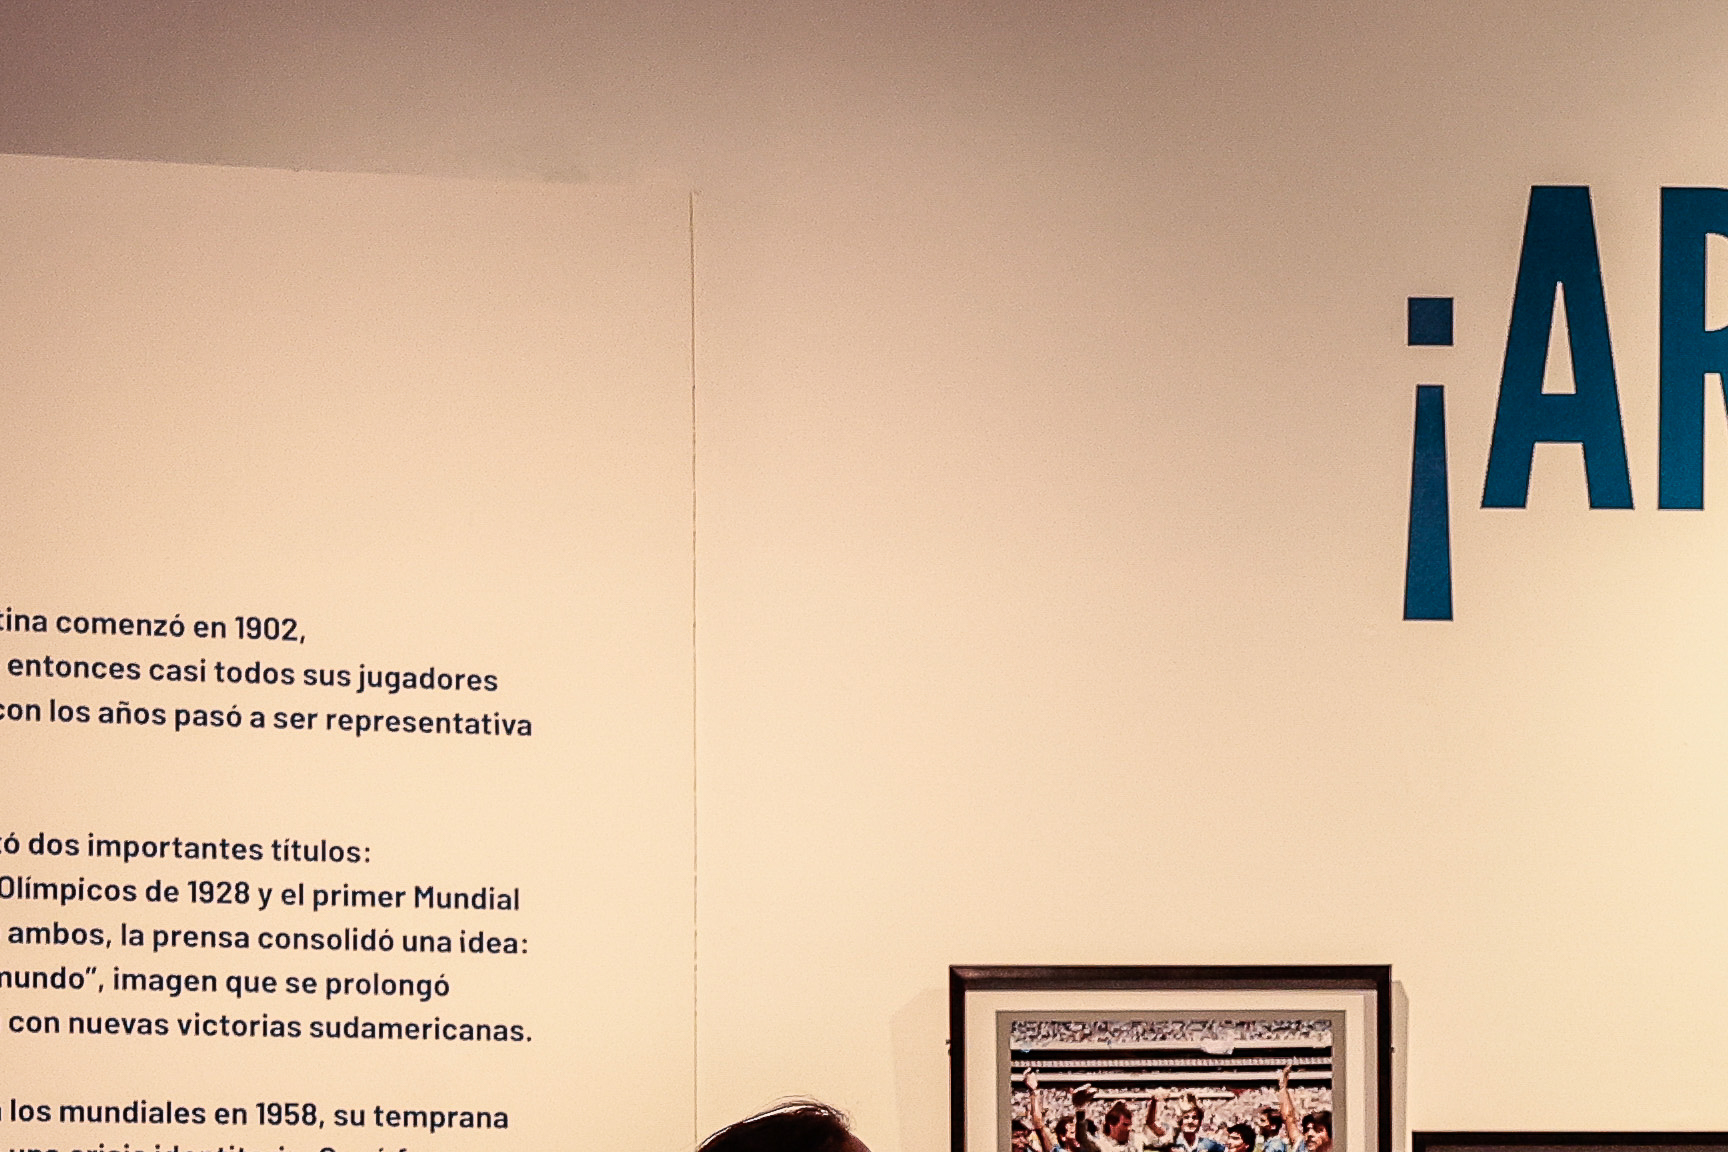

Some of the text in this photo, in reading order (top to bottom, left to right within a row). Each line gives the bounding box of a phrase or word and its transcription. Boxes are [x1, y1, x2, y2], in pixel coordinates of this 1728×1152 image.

[56, 613, 186, 638] comenzó
[193, 620, 227, 639] en
[234, 616, 306, 644] 1902,
[7, 655, 498, 695] entonces casi todos sus jugadores
[49, 698, 91, 723] los
[98, 700, 167, 726] años
[174, 704, 242, 732] pasó
[249, 711, 265, 729] a
[273, 711, 319, 730] ser
[326, 711, 532, 738] representativa
[28, 831, 80, 857] dos
[88, 832, 264, 864] importantes
[270, 838, 370, 864] títulos:
[145, 879, 180, 904] de
[187, 880, 250, 905] 1928
[257, 887, 273, 912] y
[280, 882, 304, 906] el
[313, 883, 407, 912] primer
[414, 885, 520, 911] Mundial
[7, 921, 528, 954] ambos, la prensa consolidó una idea:
[113, 966, 217, 998] imagen
[225, 975, 278, 999] que
[285, 976, 318, 994] se
[325, 972, 450, 1003] prolongó
[8, 1011, 532, 1043] con nuevas victorias sudamericanas.
[10, 1098, 52, 1123] los
[59, 1099, 206, 1125] mundiales
[214, 1107, 248, 1126] en
[255, 1102, 325, 1130] 1958,
[333, 1109, 365, 1127] su
[373, 1105, 509, 1134] temprana
